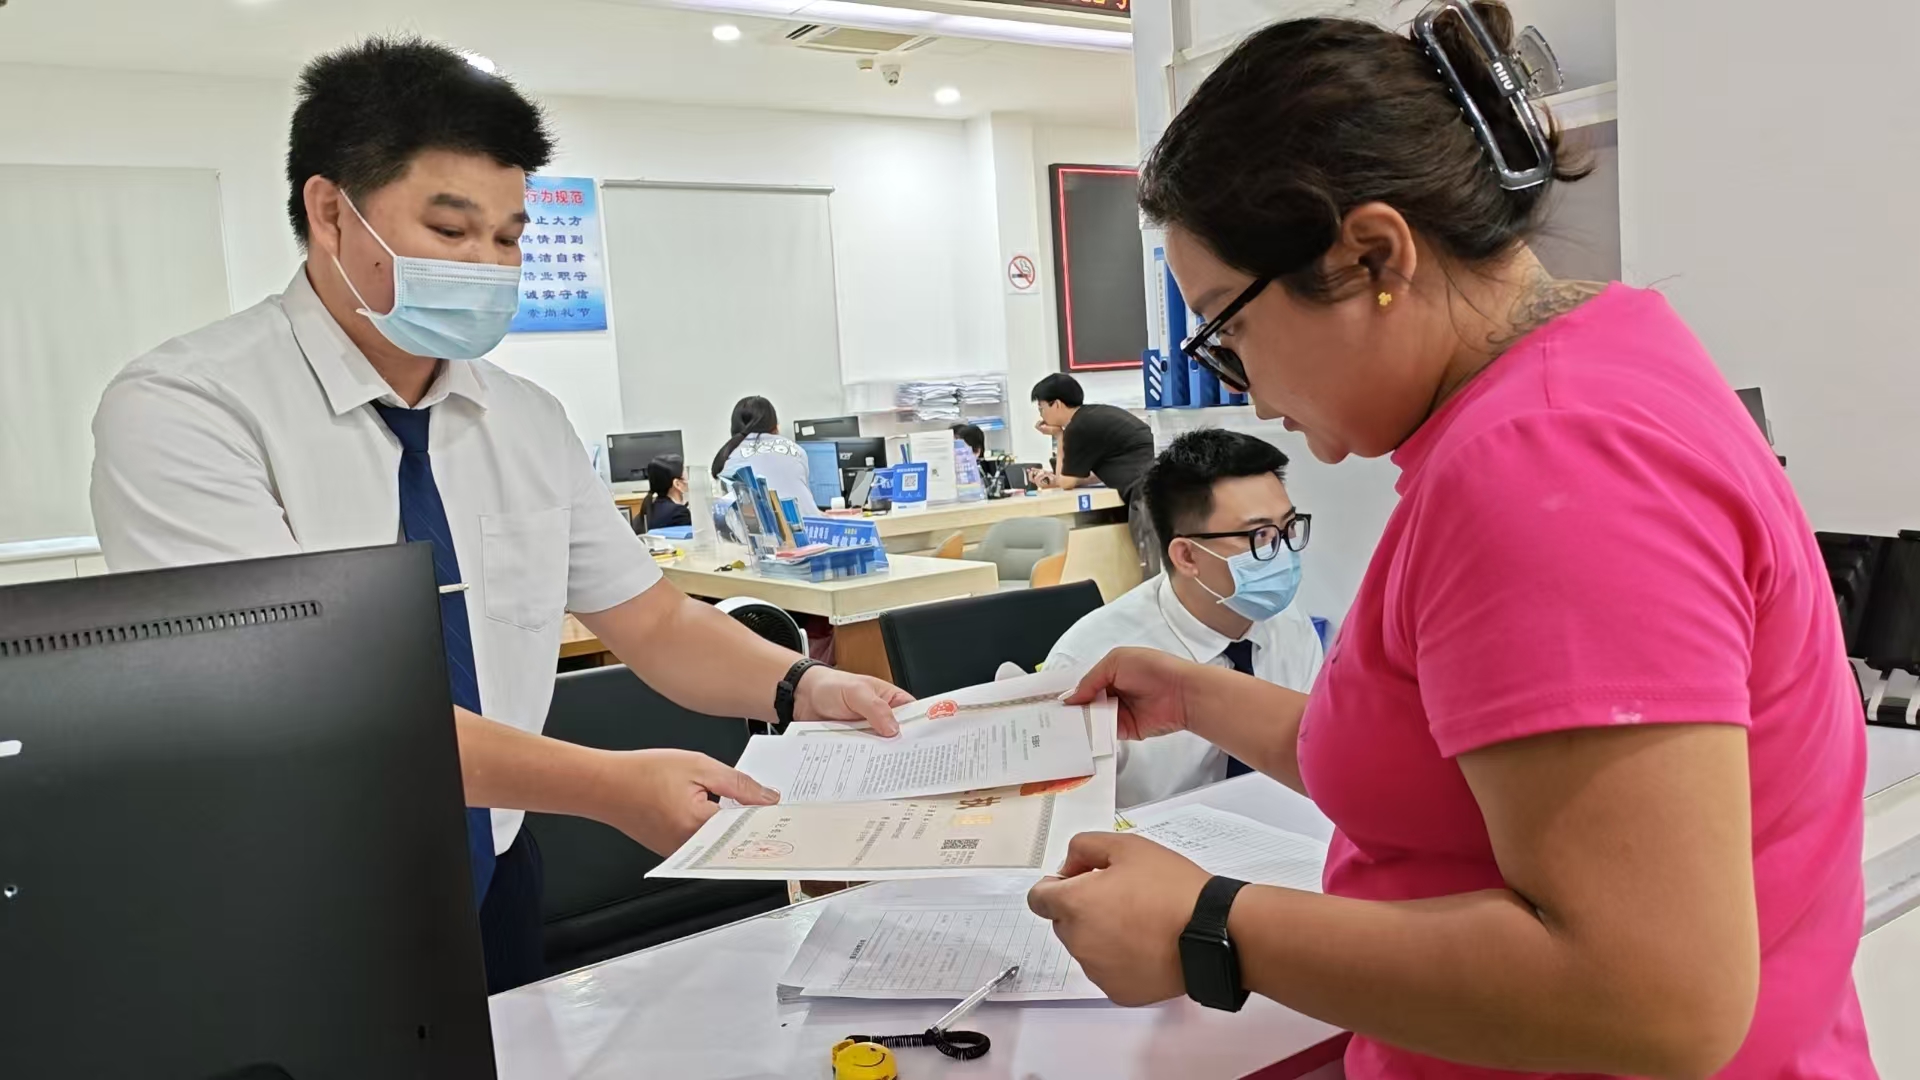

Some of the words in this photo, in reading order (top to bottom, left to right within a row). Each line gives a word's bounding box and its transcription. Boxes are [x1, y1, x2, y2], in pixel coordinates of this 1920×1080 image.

[525, 189, 584, 204] 行为规范
[534, 215, 583, 226] 止大方
[524, 289, 589, 300] 诚实守信
[1081, 495, 1089, 509] 5
